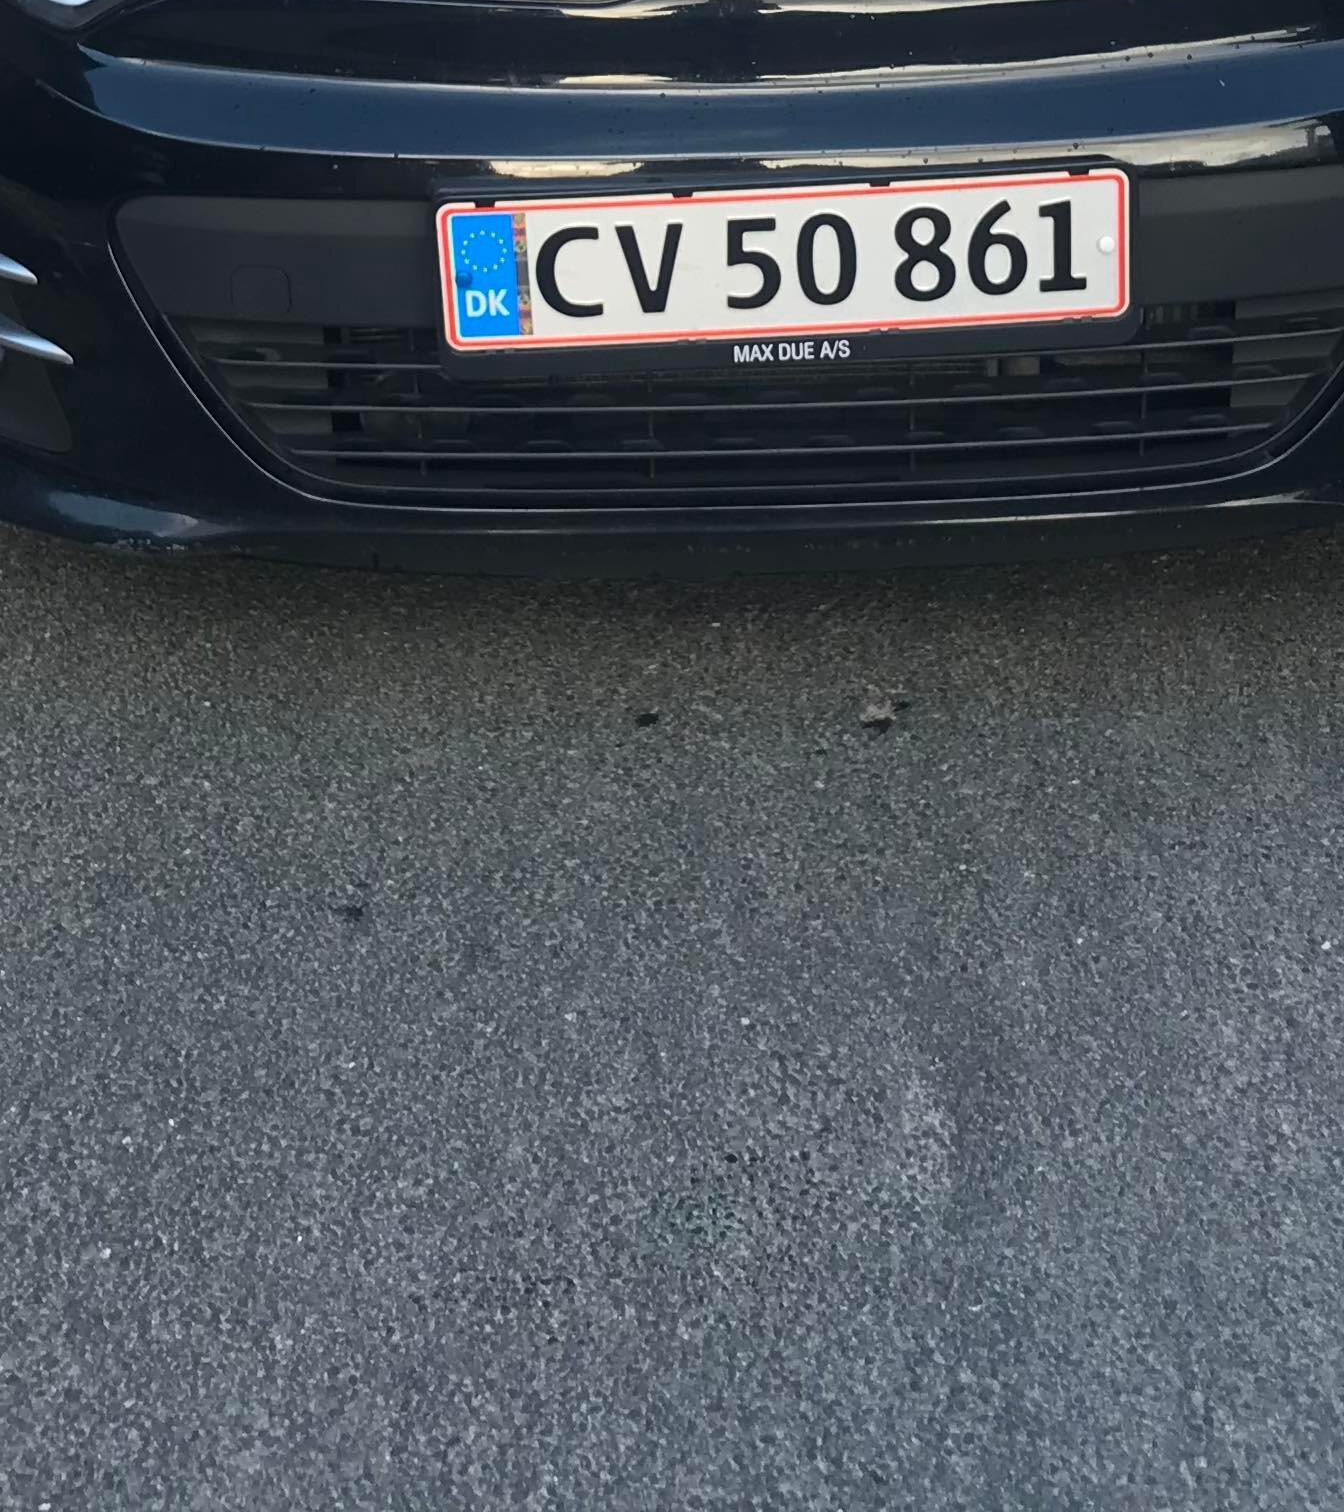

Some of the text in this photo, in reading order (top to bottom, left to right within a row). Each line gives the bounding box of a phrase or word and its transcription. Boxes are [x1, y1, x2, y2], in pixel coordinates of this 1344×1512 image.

[535, 200, 1088, 318] CV 50 861
[464, 288, 511, 318] DK
[733, 339, 851, 363] MAX DUE A/S
